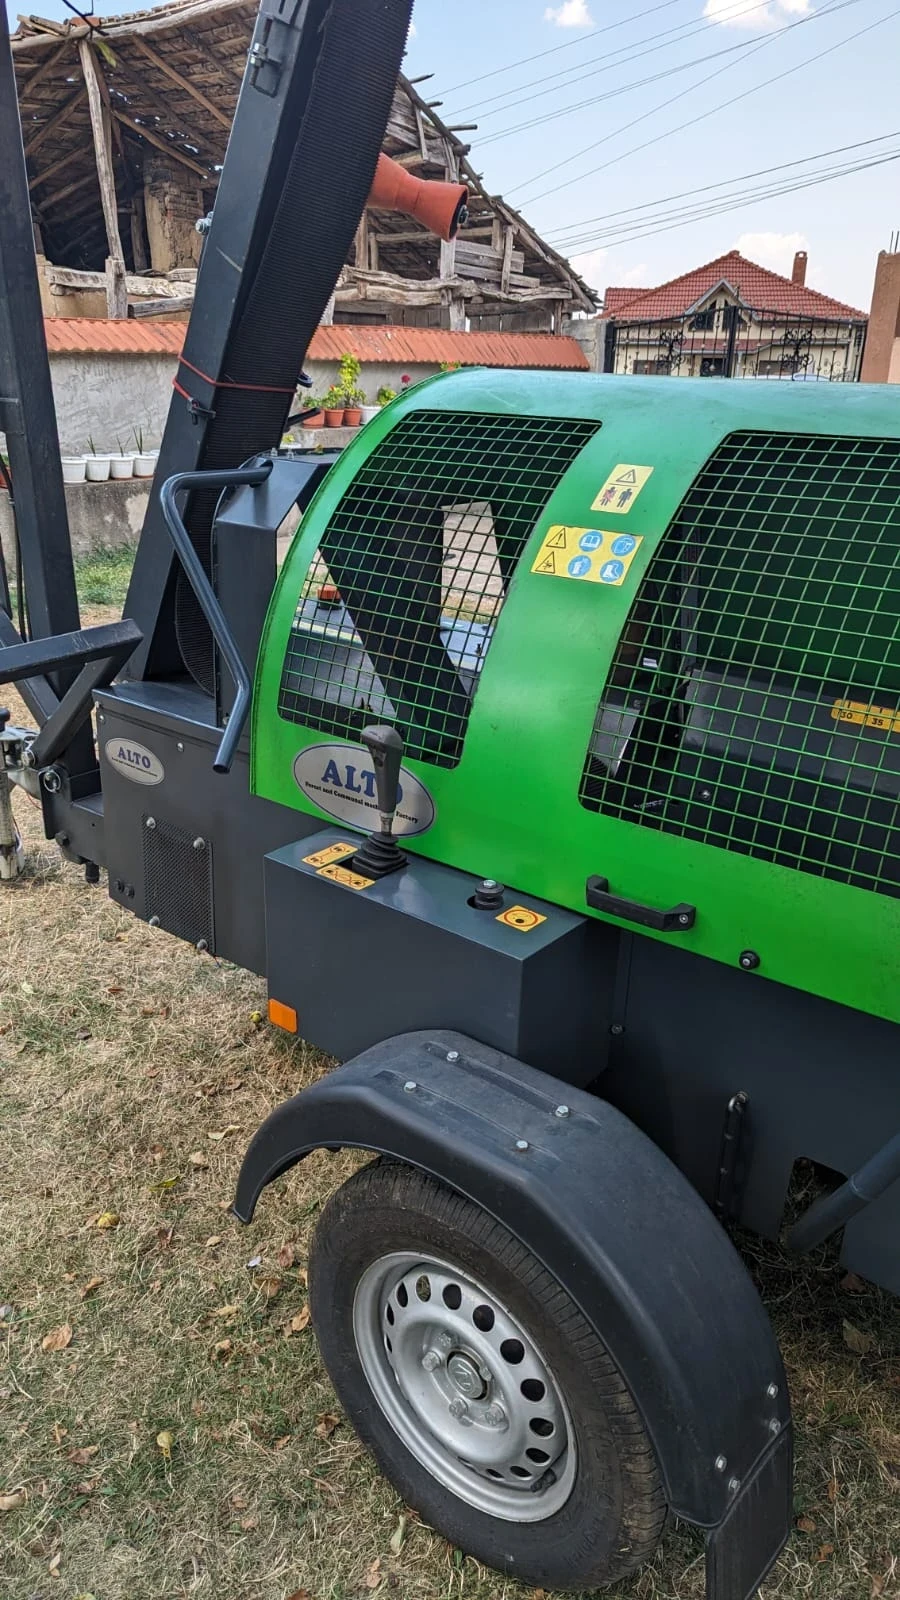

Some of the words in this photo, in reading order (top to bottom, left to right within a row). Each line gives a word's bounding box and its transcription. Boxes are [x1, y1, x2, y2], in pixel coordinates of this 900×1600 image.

[872, 718, 884, 726] 35
[118, 746, 151, 769] ALTO
[305, 781, 321, 791] Forest
[322, 787, 333, 795] and
[333, 789, 363, 805] Communal
[396, 810, 418, 824] Factory
